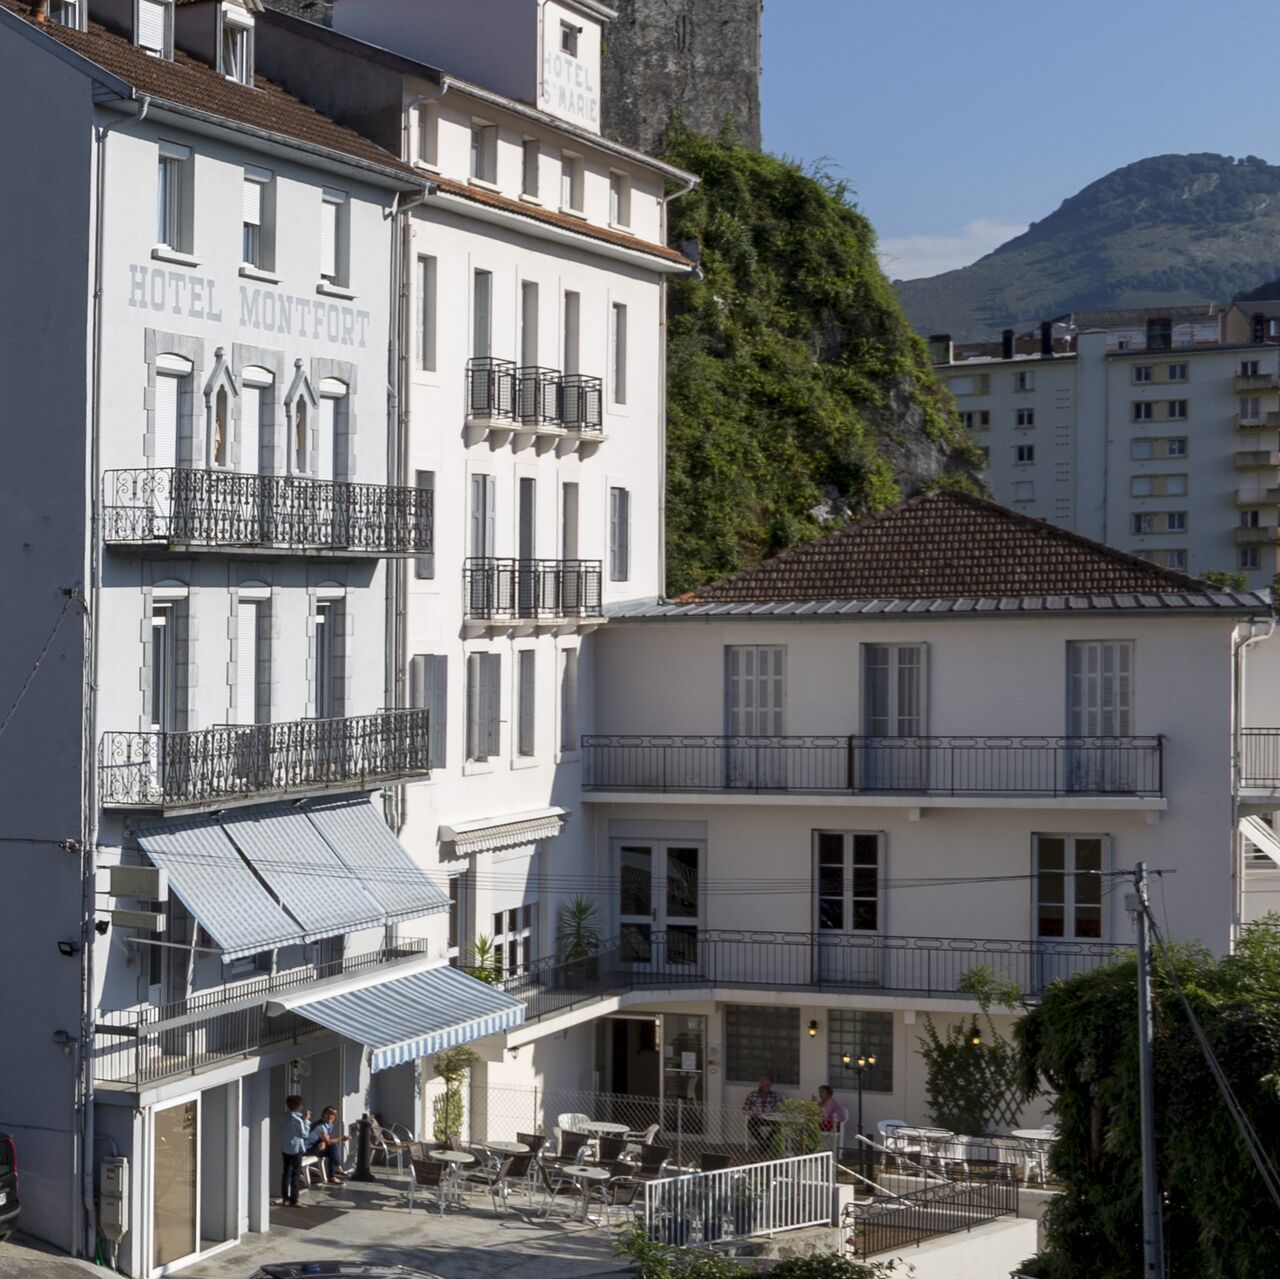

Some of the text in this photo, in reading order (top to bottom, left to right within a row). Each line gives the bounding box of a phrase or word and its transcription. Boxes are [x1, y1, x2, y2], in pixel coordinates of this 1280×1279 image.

[543, 50, 593, 92] HOTEL
[559, 86, 597, 122] MARIE
[128, 263, 370, 348] HOTEL MONTFORT
